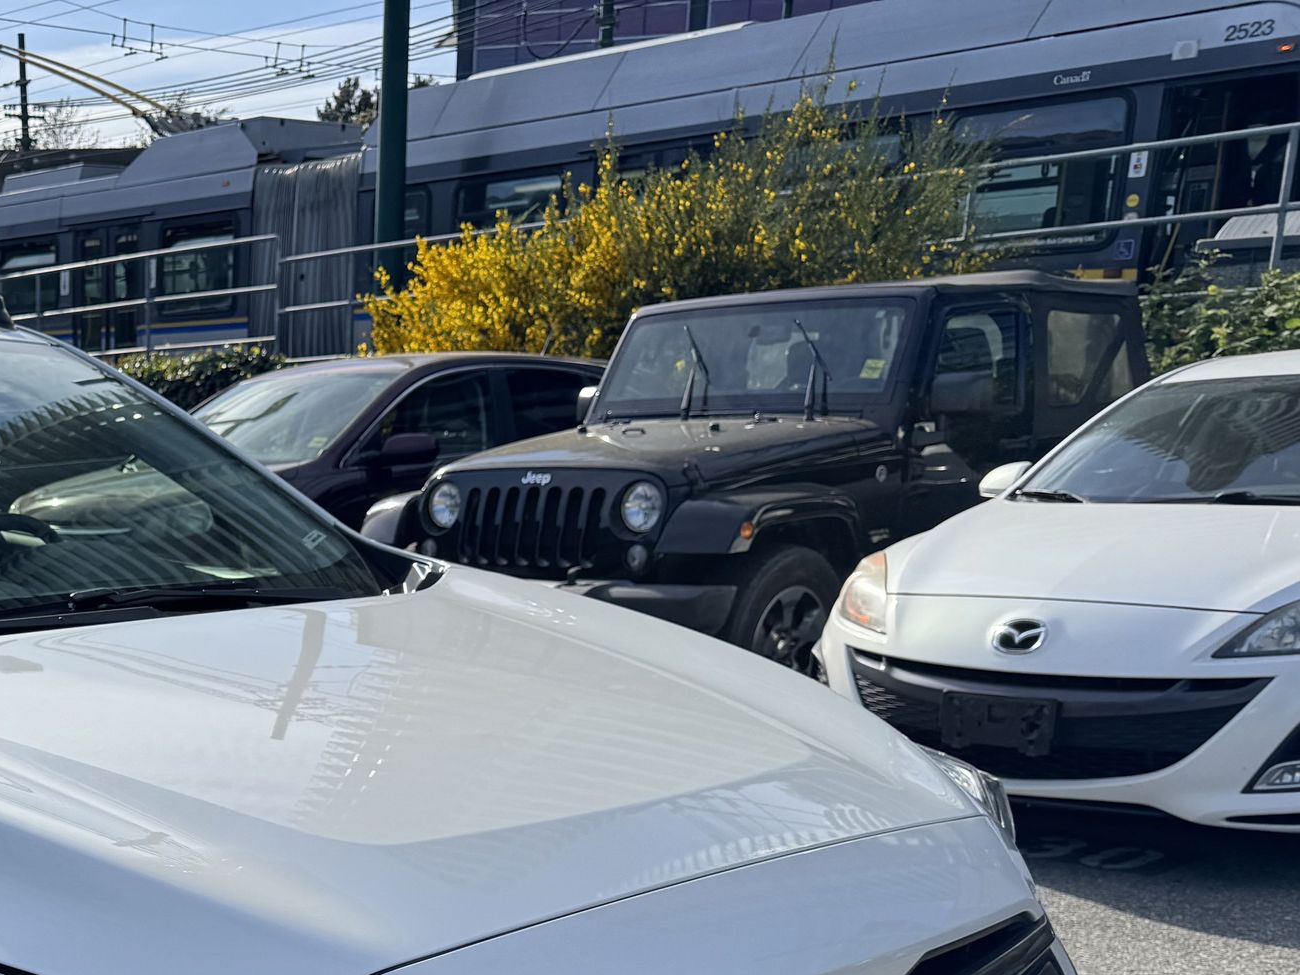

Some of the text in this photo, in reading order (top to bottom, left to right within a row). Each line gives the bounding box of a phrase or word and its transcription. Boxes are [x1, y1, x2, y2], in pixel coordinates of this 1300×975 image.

[1224, 19, 1276, 42] 2523
[1053, 70, 1091, 86] Canada
[521, 471, 552, 486] Jeep
